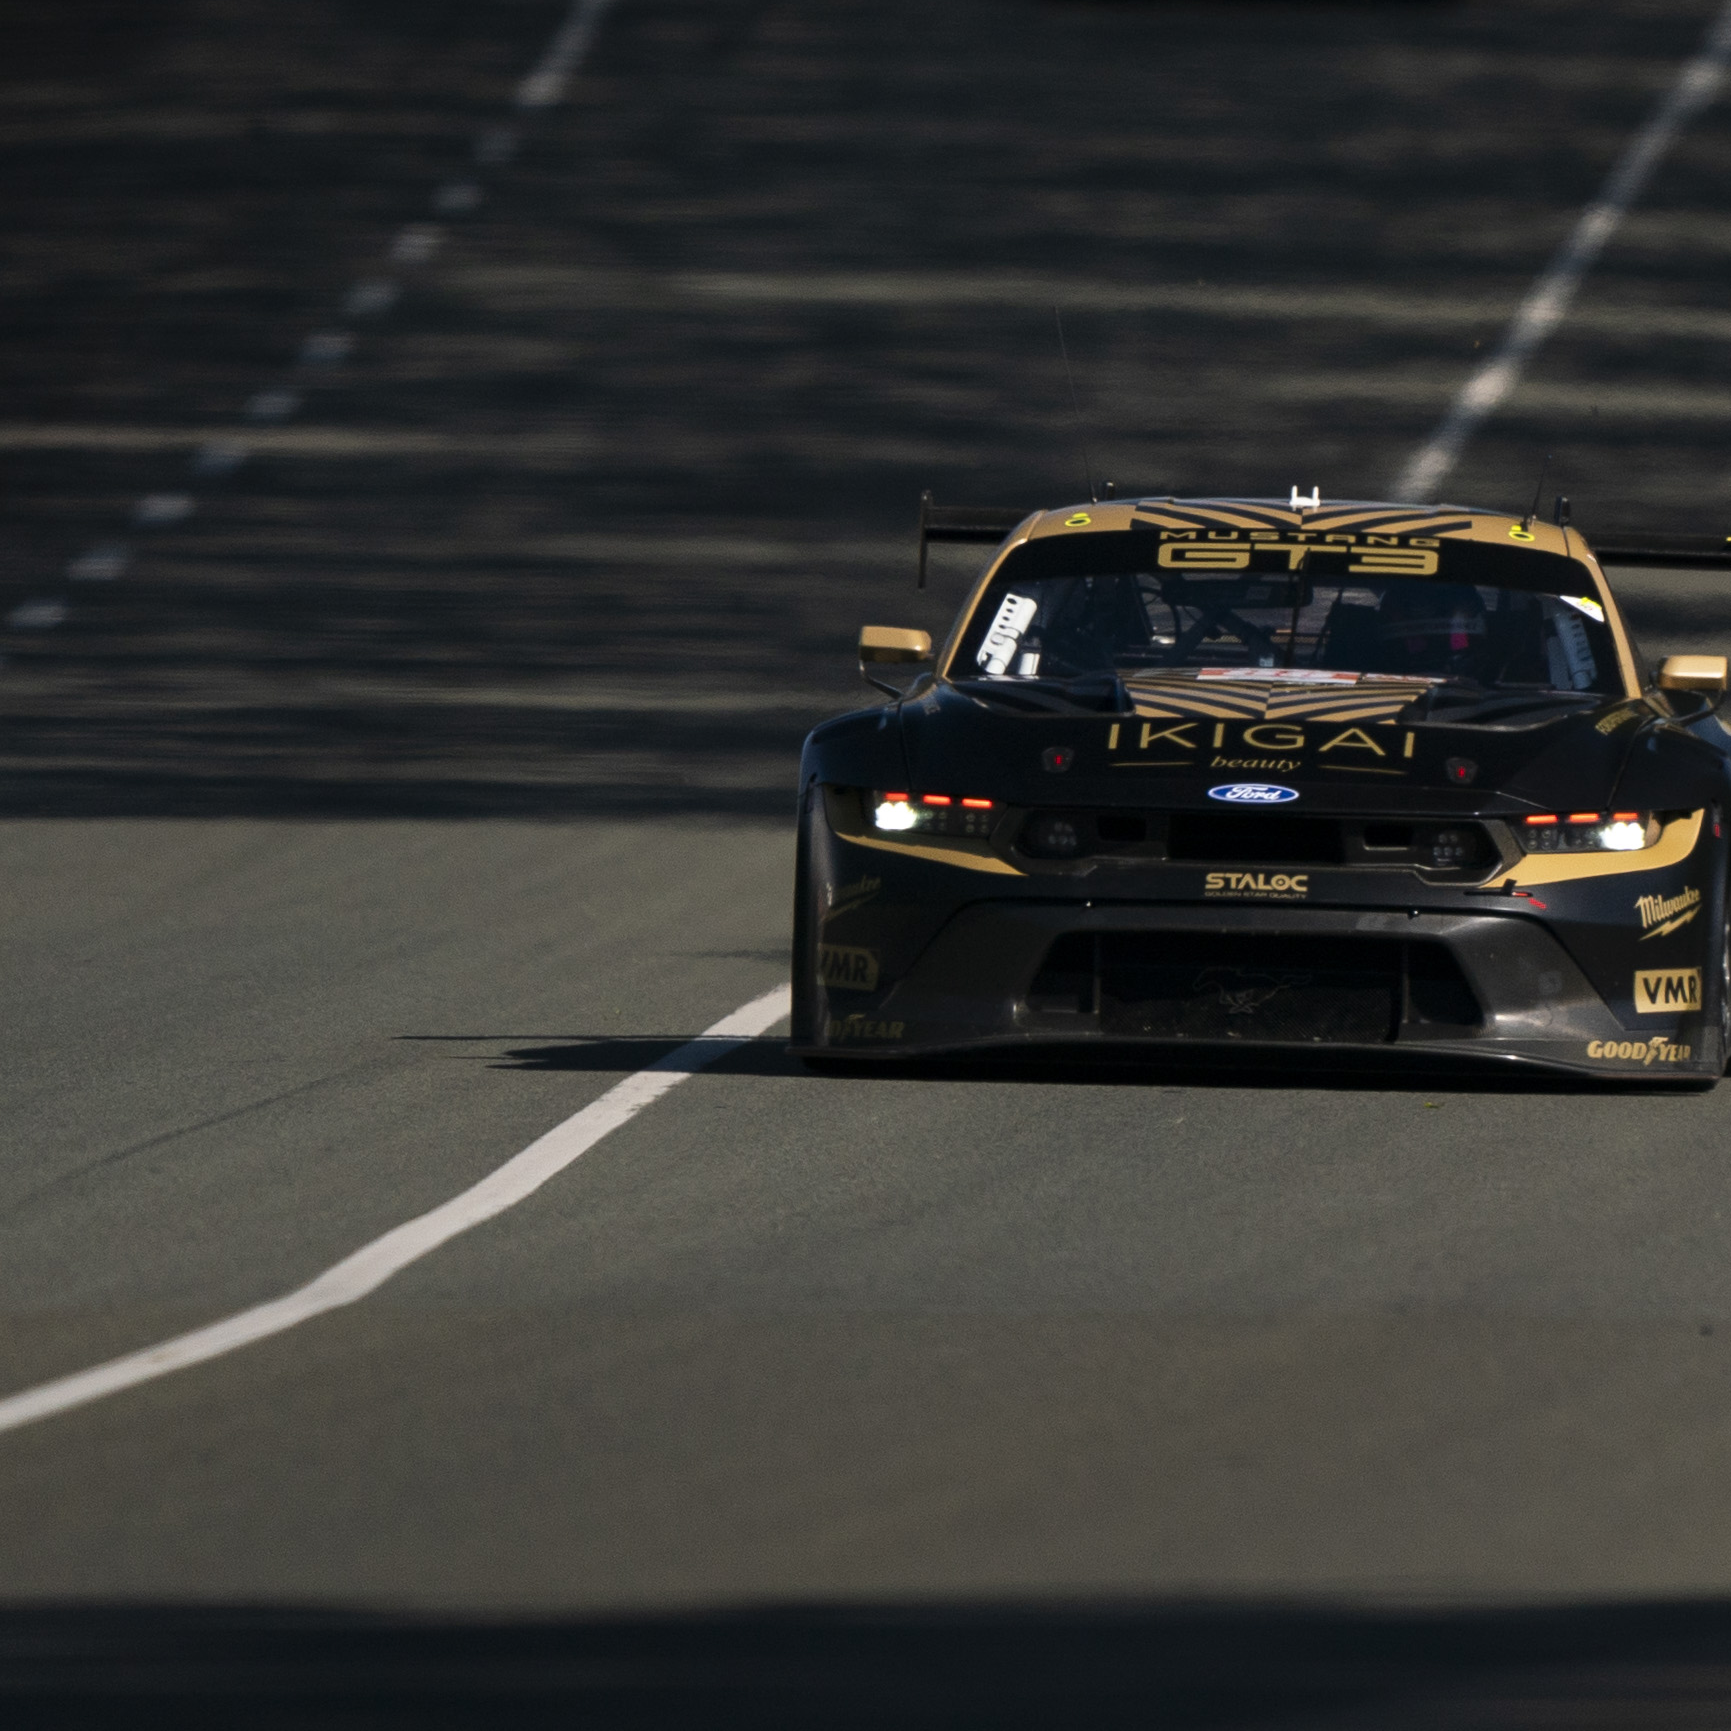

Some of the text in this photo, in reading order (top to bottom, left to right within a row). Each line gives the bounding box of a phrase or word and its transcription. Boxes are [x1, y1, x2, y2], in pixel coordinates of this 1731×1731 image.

[1159, 530, 1442, 548] MUSTANG
[1157, 542, 1440, 576] GT3
[1108, 722, 1416, 759] IKIGAI
[1210, 756, 1301, 773] beauty
[1225, 786, 1283, 801] Ford
[1204, 872, 1310, 893] STALOC
[1642, 974, 1698, 1005] VMR
